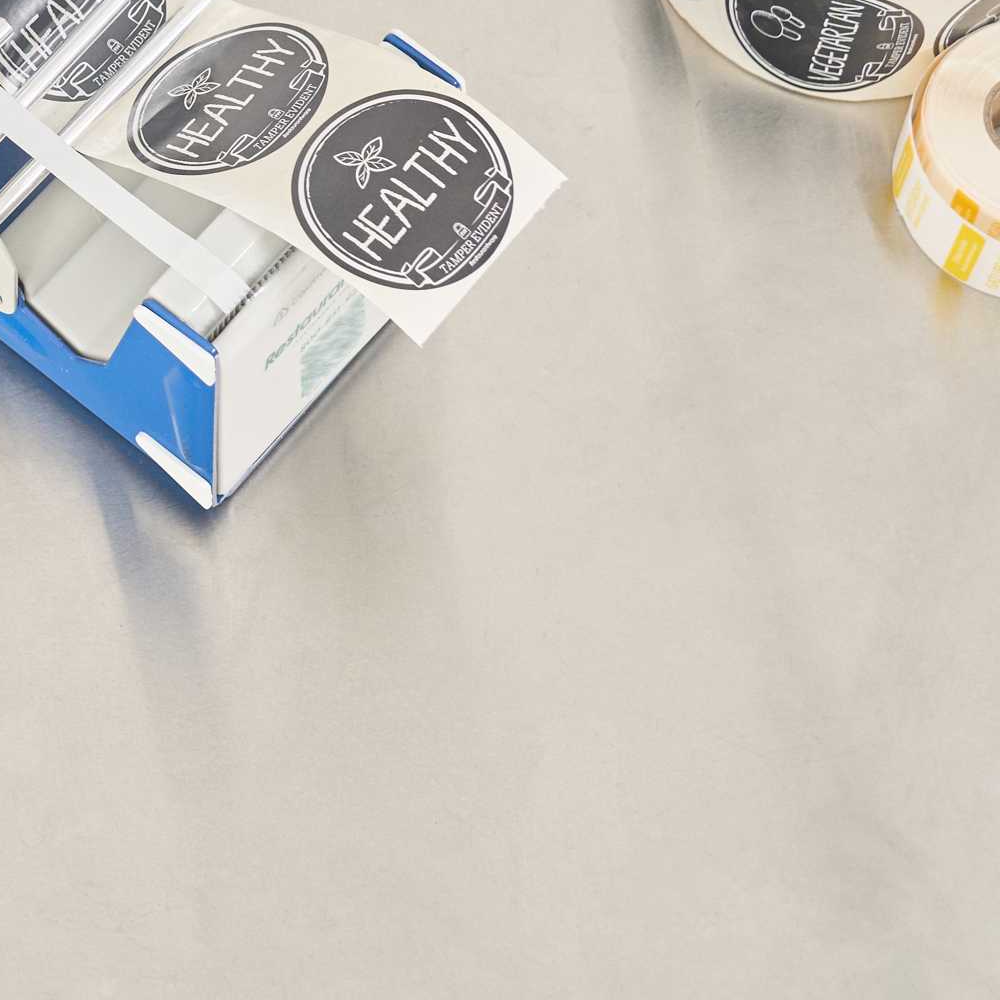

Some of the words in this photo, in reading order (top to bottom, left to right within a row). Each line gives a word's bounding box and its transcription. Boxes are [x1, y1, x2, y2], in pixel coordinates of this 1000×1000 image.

[92, 54, 128, 87] TAMPER
[124, 20, 155, 57] EVIDENT
[808, 0, 865, 82] VEGETARIAN
[166, 37, 295, 158] HEALTHY
[253, 118, 289, 149] TAMPER
[285, 83, 317, 119] EVIDENT
[342, 116, 477, 261] HEALTHY
[439, 239, 476, 274] TAMPER
[470, 202, 503, 243] EVIDENT
